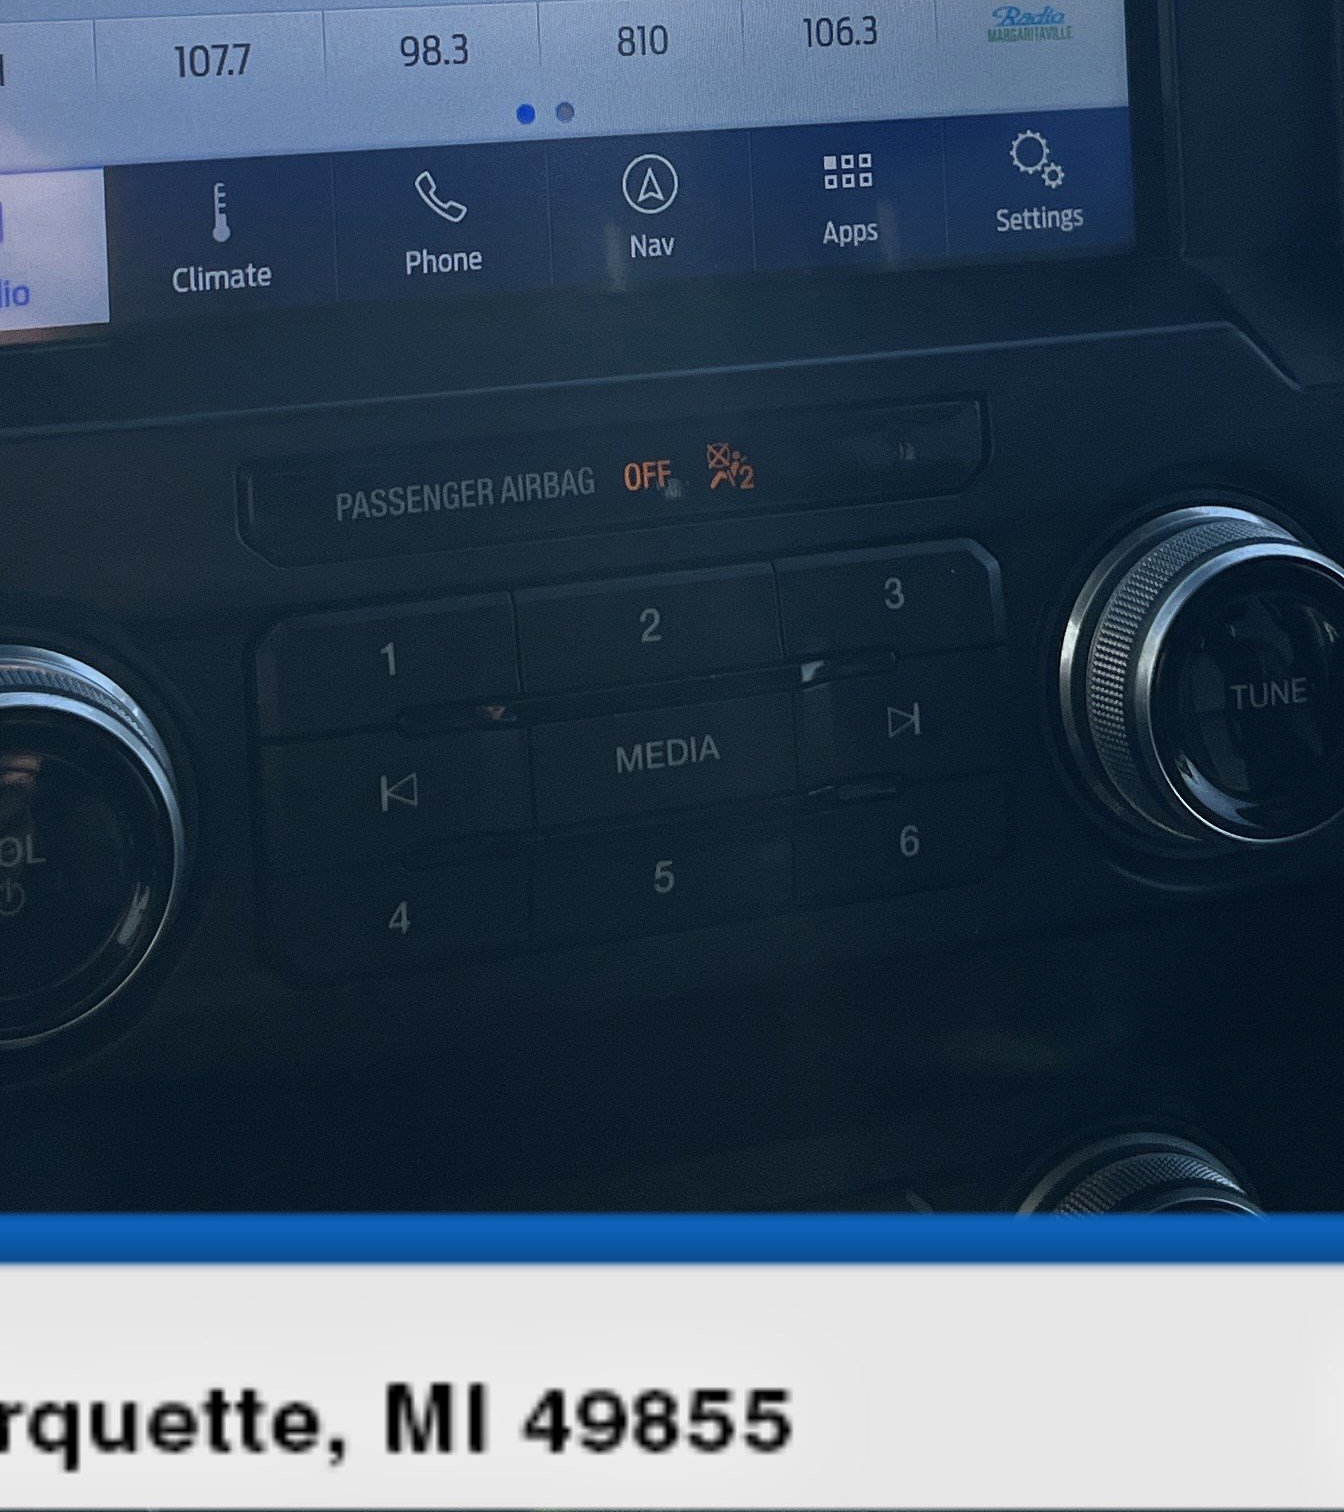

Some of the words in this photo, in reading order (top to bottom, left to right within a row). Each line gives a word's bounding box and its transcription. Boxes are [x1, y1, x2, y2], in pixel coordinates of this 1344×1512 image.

[803, 15, 879, 49] 106.3
[992, 5, 1065, 27] Radio
[399, 34, 469, 67] 98.3
[617, 24, 669, 56] 810
[174, 43, 252, 78] 107.7
[822, 221, 879, 248] Apps
[995, 204, 1084, 236] Settings
[405, 247, 483, 276] Phone
[630, 233, 675, 259] Nav
[172, 262, 272, 294] Climate
[335, 477, 494, 522] PASSENGER
[500, 466, 596, 504] AIRBAG
[623, 459, 672, 492] OFF
[883, 578, 905, 609] 3
[639, 608, 662, 643] 2
[380, 643, 397, 676] 1
[1230, 677, 1307, 710] TUNE
[615, 733, 722, 775] MEDIA
[899, 825, 920, 857] 6
[653, 860, 675, 894] 5
[388, 901, 411, 935] 4
